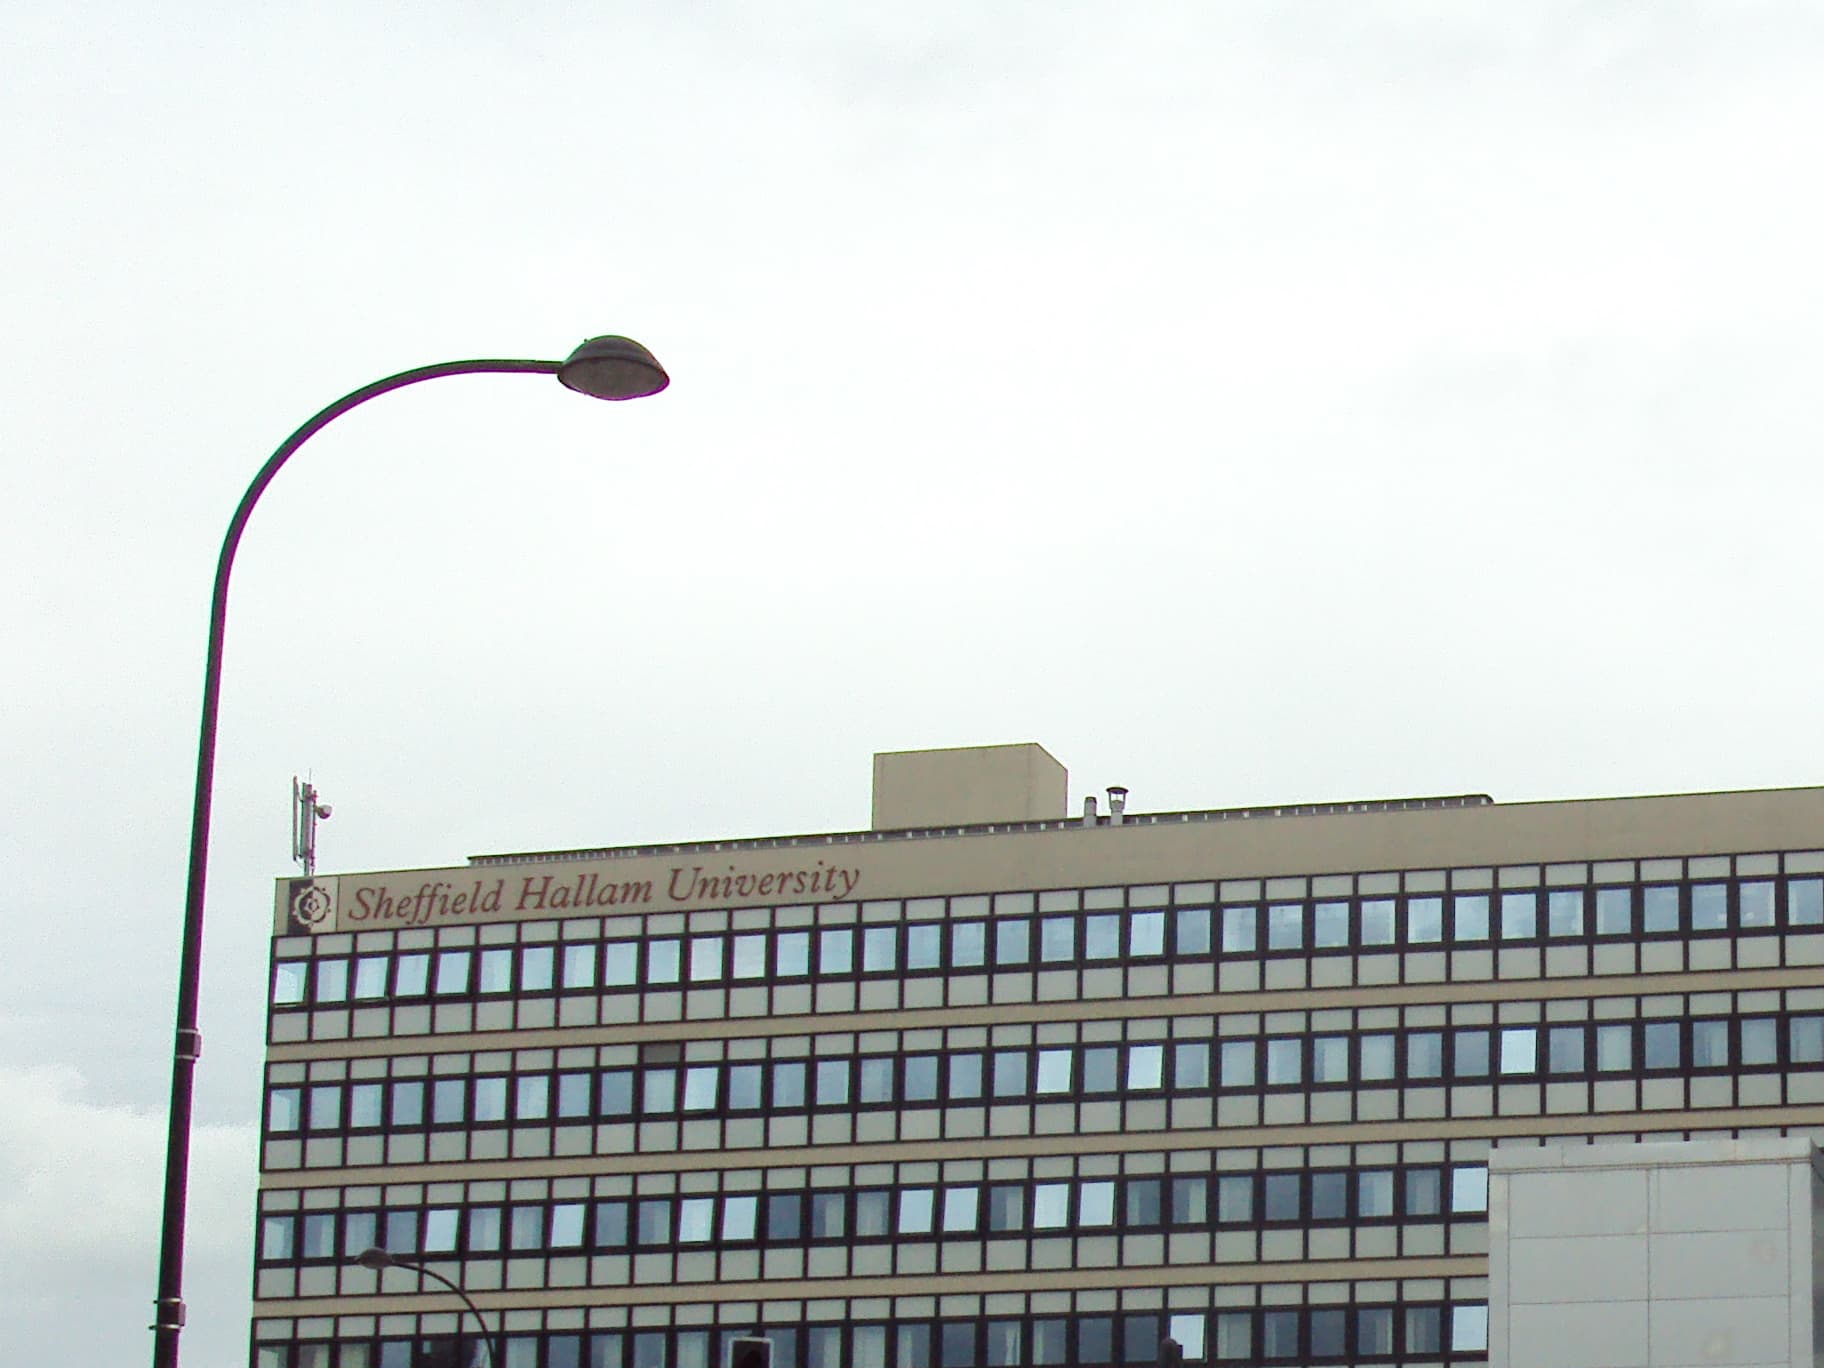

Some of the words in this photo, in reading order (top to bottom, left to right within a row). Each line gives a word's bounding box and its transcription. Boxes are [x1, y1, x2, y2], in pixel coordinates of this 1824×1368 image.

[348, 878, 502, 925] Sheffield
[515, 873, 653, 910] Hallam
[668, 859, 861, 903] University
